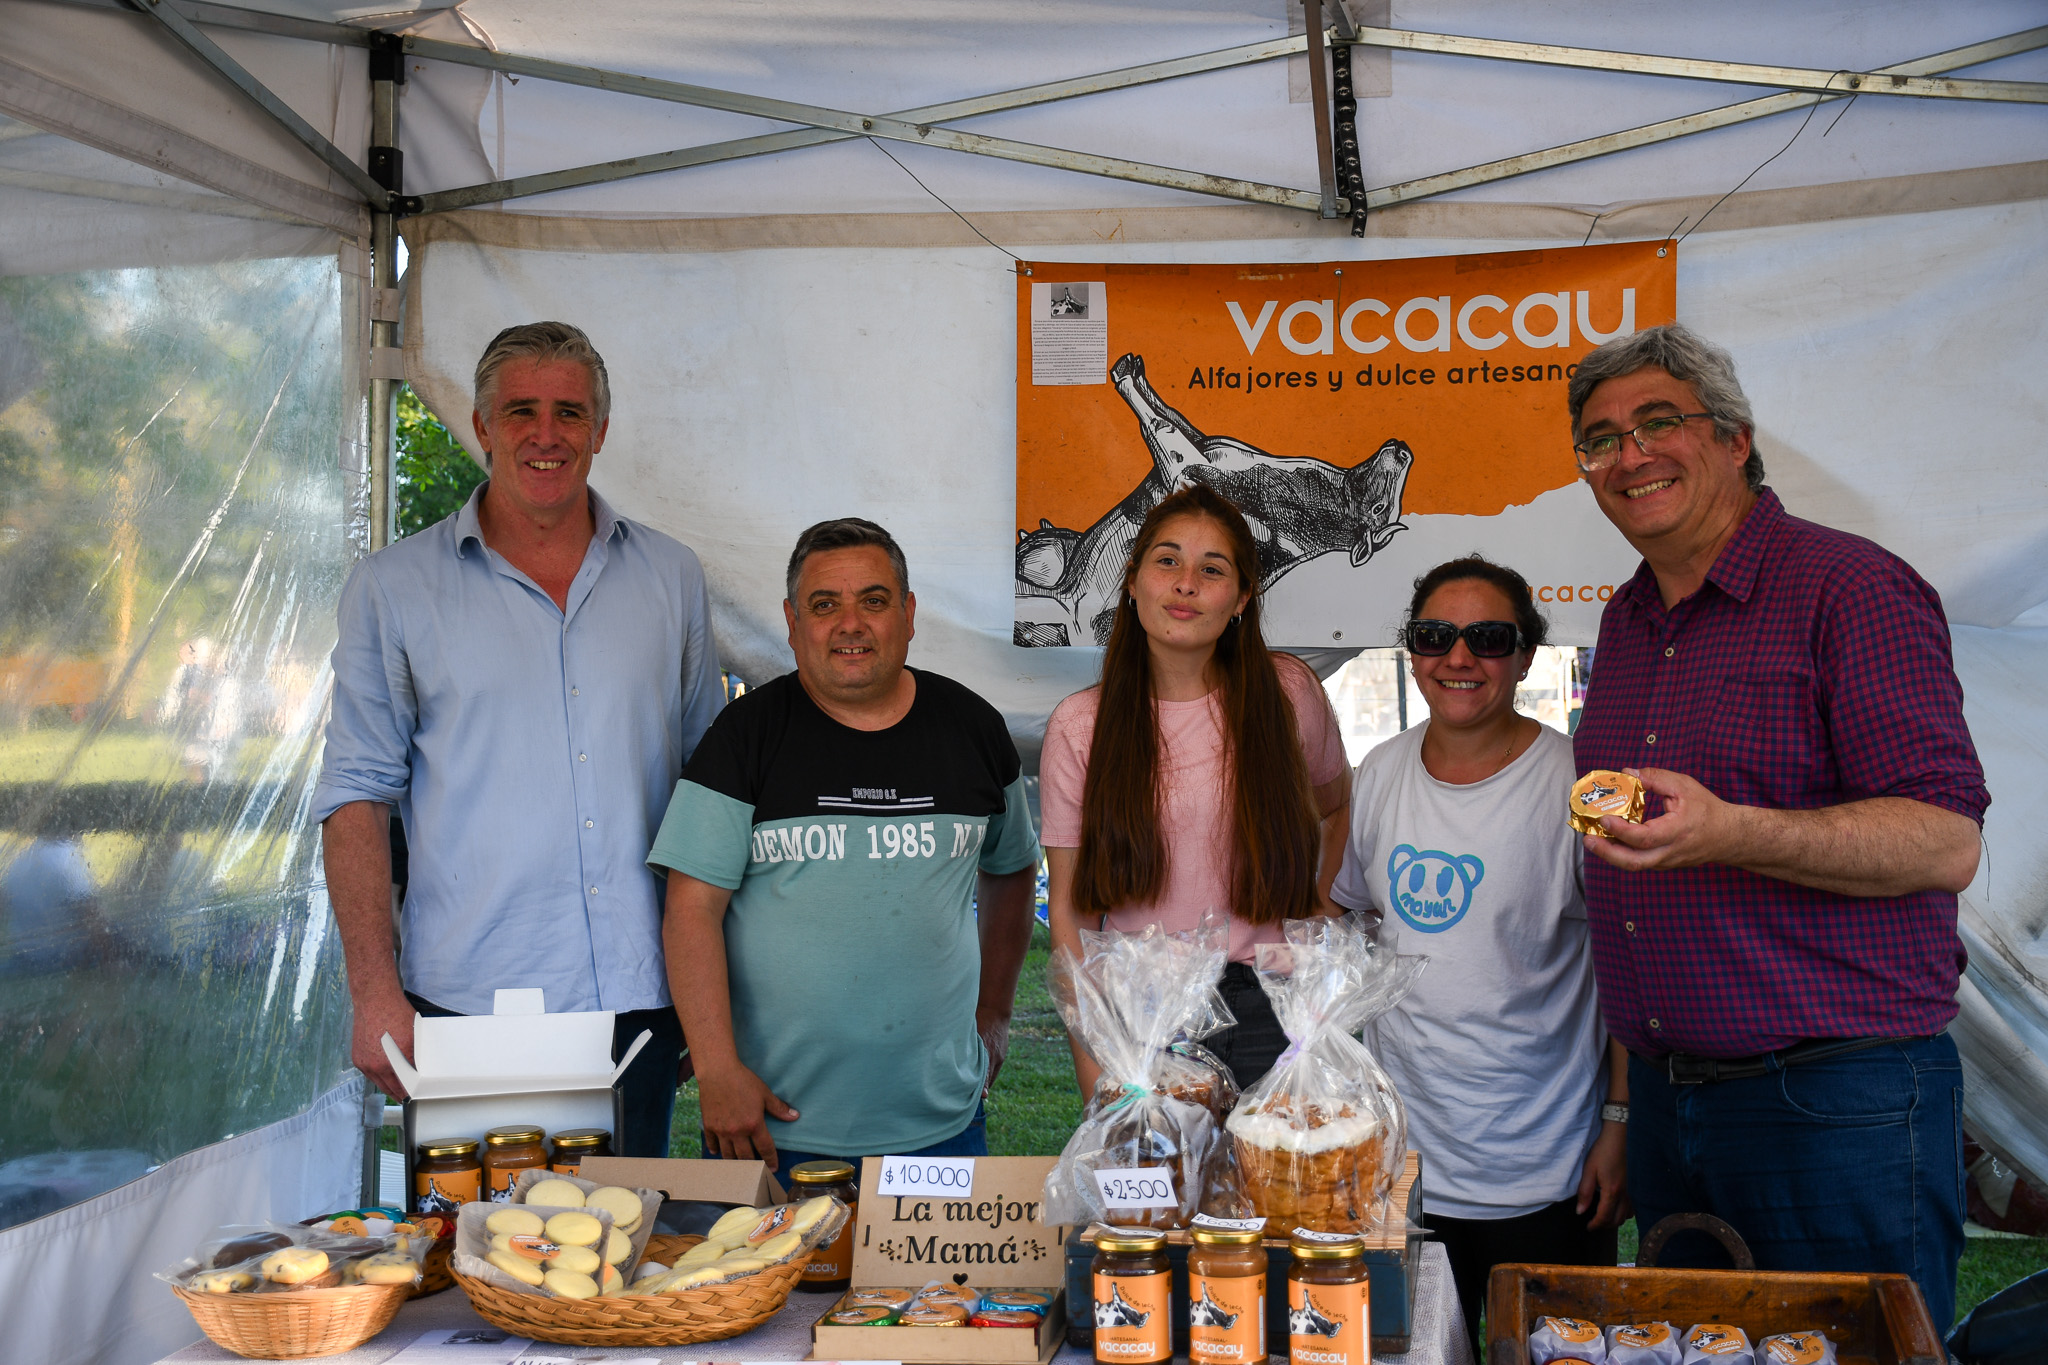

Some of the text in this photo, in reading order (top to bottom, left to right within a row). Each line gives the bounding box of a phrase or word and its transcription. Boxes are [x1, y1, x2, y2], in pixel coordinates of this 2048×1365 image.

[1188, 366, 1318, 393] Alfajores
[1327, 370, 1343, 392] y
[1355, 363, 1436, 386] dulce
[867, 821, 936, 859] 1985
[1103, 1178, 1169, 1200] $2500
[892, 1194, 1039, 1228] La mejor
[904, 1235, 1020, 1264] Mamá
[806, 1262, 839, 1276] acay
[1120, 1286, 1132, 1301] Dulce
[1208, 1285, 1220, 1302] Dulce
[1311, 1294, 1323, 1310] Dulce
[1099, 1340, 1156, 1357] vacacay
[1191, 1339, 1244, 1359] vacacay
[1291, 1346, 1348, 1365] vacacay
